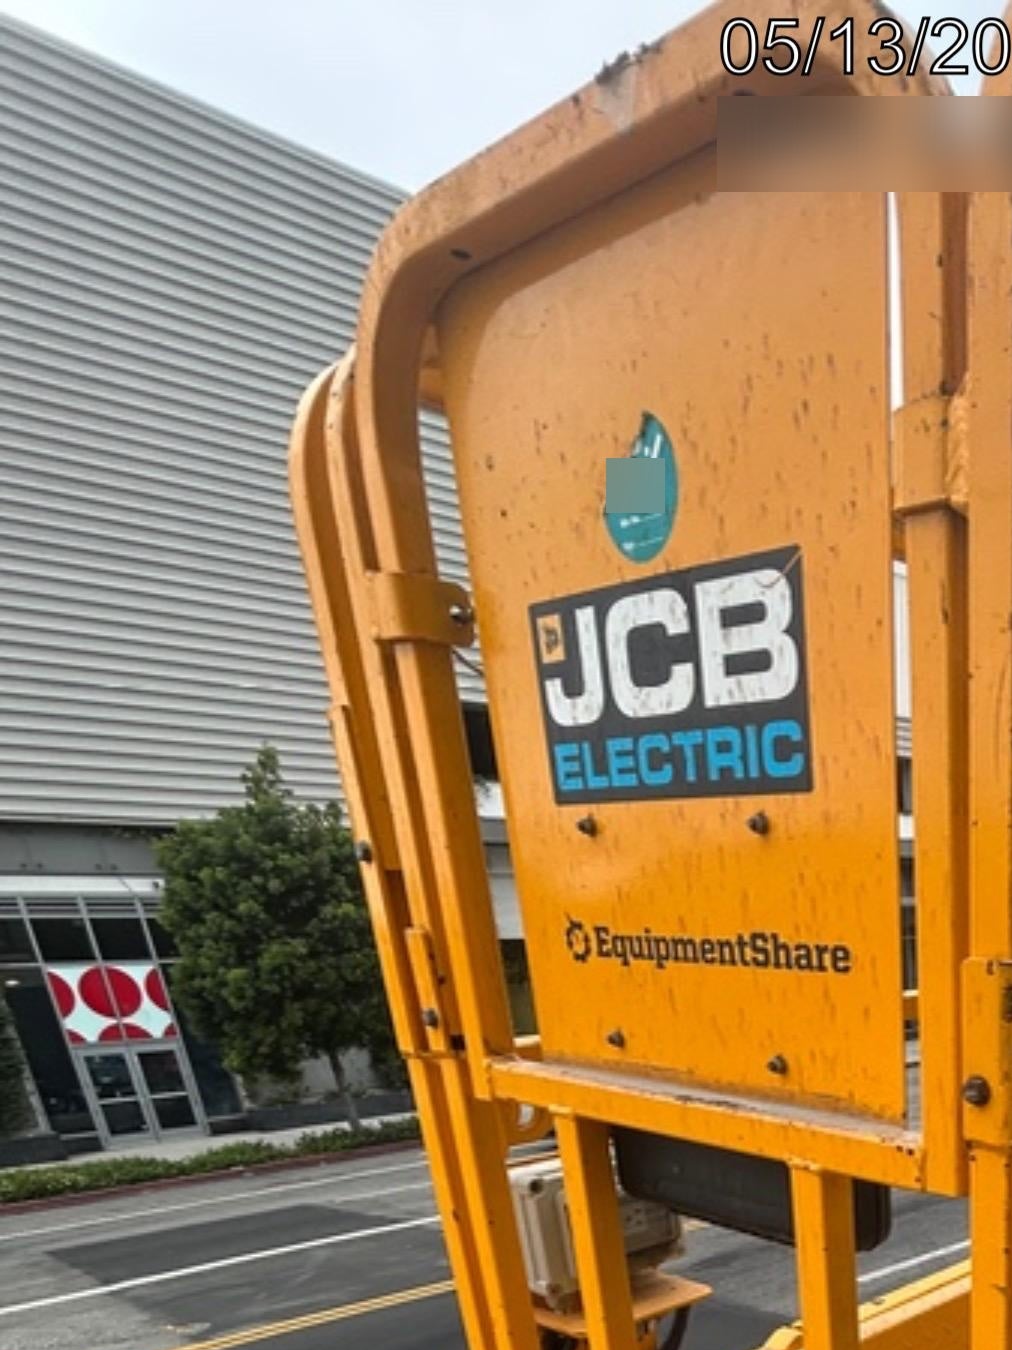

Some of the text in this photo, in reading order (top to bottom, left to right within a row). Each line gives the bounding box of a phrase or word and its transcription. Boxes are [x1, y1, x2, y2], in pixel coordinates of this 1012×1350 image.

[545, 568, 800, 728] JCB
[554, 720, 805, 793] ELECTRIC
[594, 926, 852, 974] EquipmentShare
